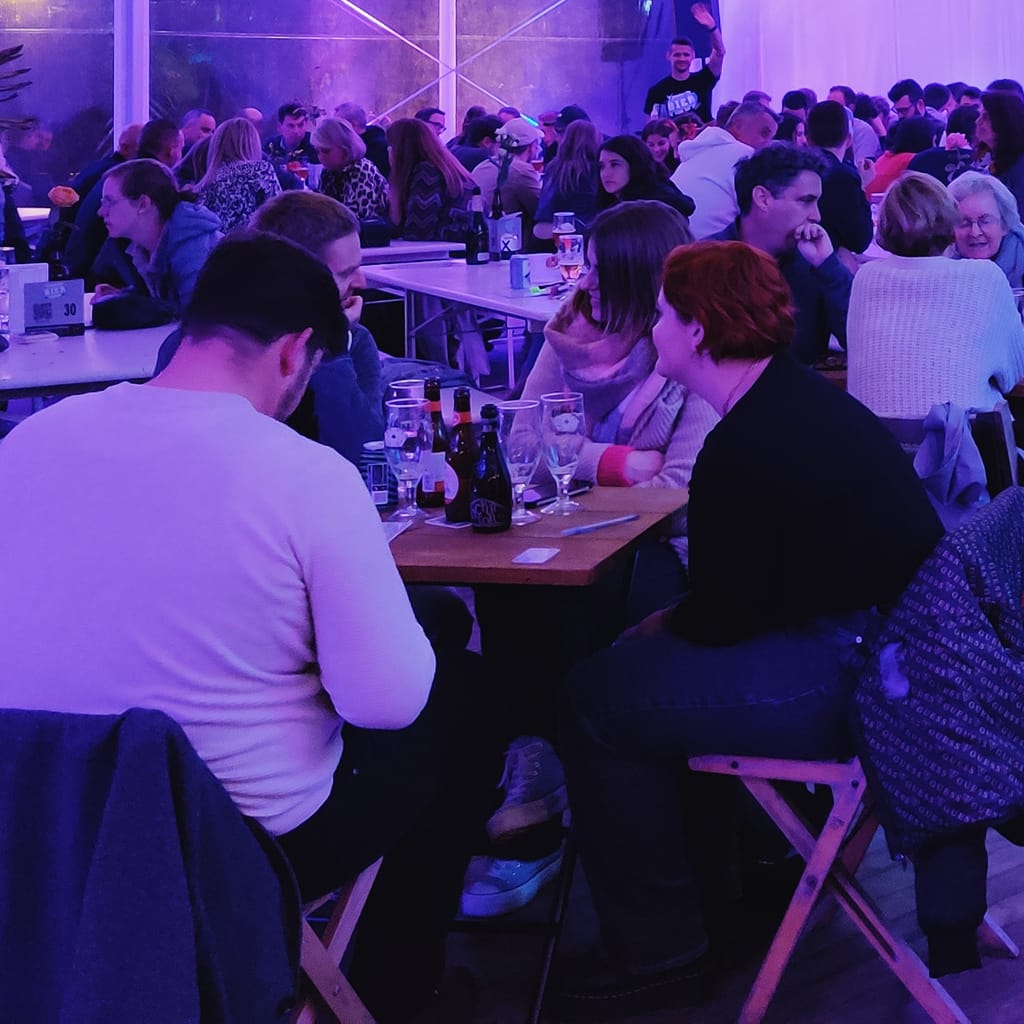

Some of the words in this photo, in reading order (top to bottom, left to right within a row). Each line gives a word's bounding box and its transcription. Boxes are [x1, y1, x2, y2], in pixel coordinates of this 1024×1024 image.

[64, 303, 76, 316] 30
[954, 628, 985, 650] GUESS
[968, 651, 998, 676] GUESS
[916, 705, 948, 726] GUESS
[928, 728, 962, 751] GUESS
[969, 750, 1001, 774] GUESS
